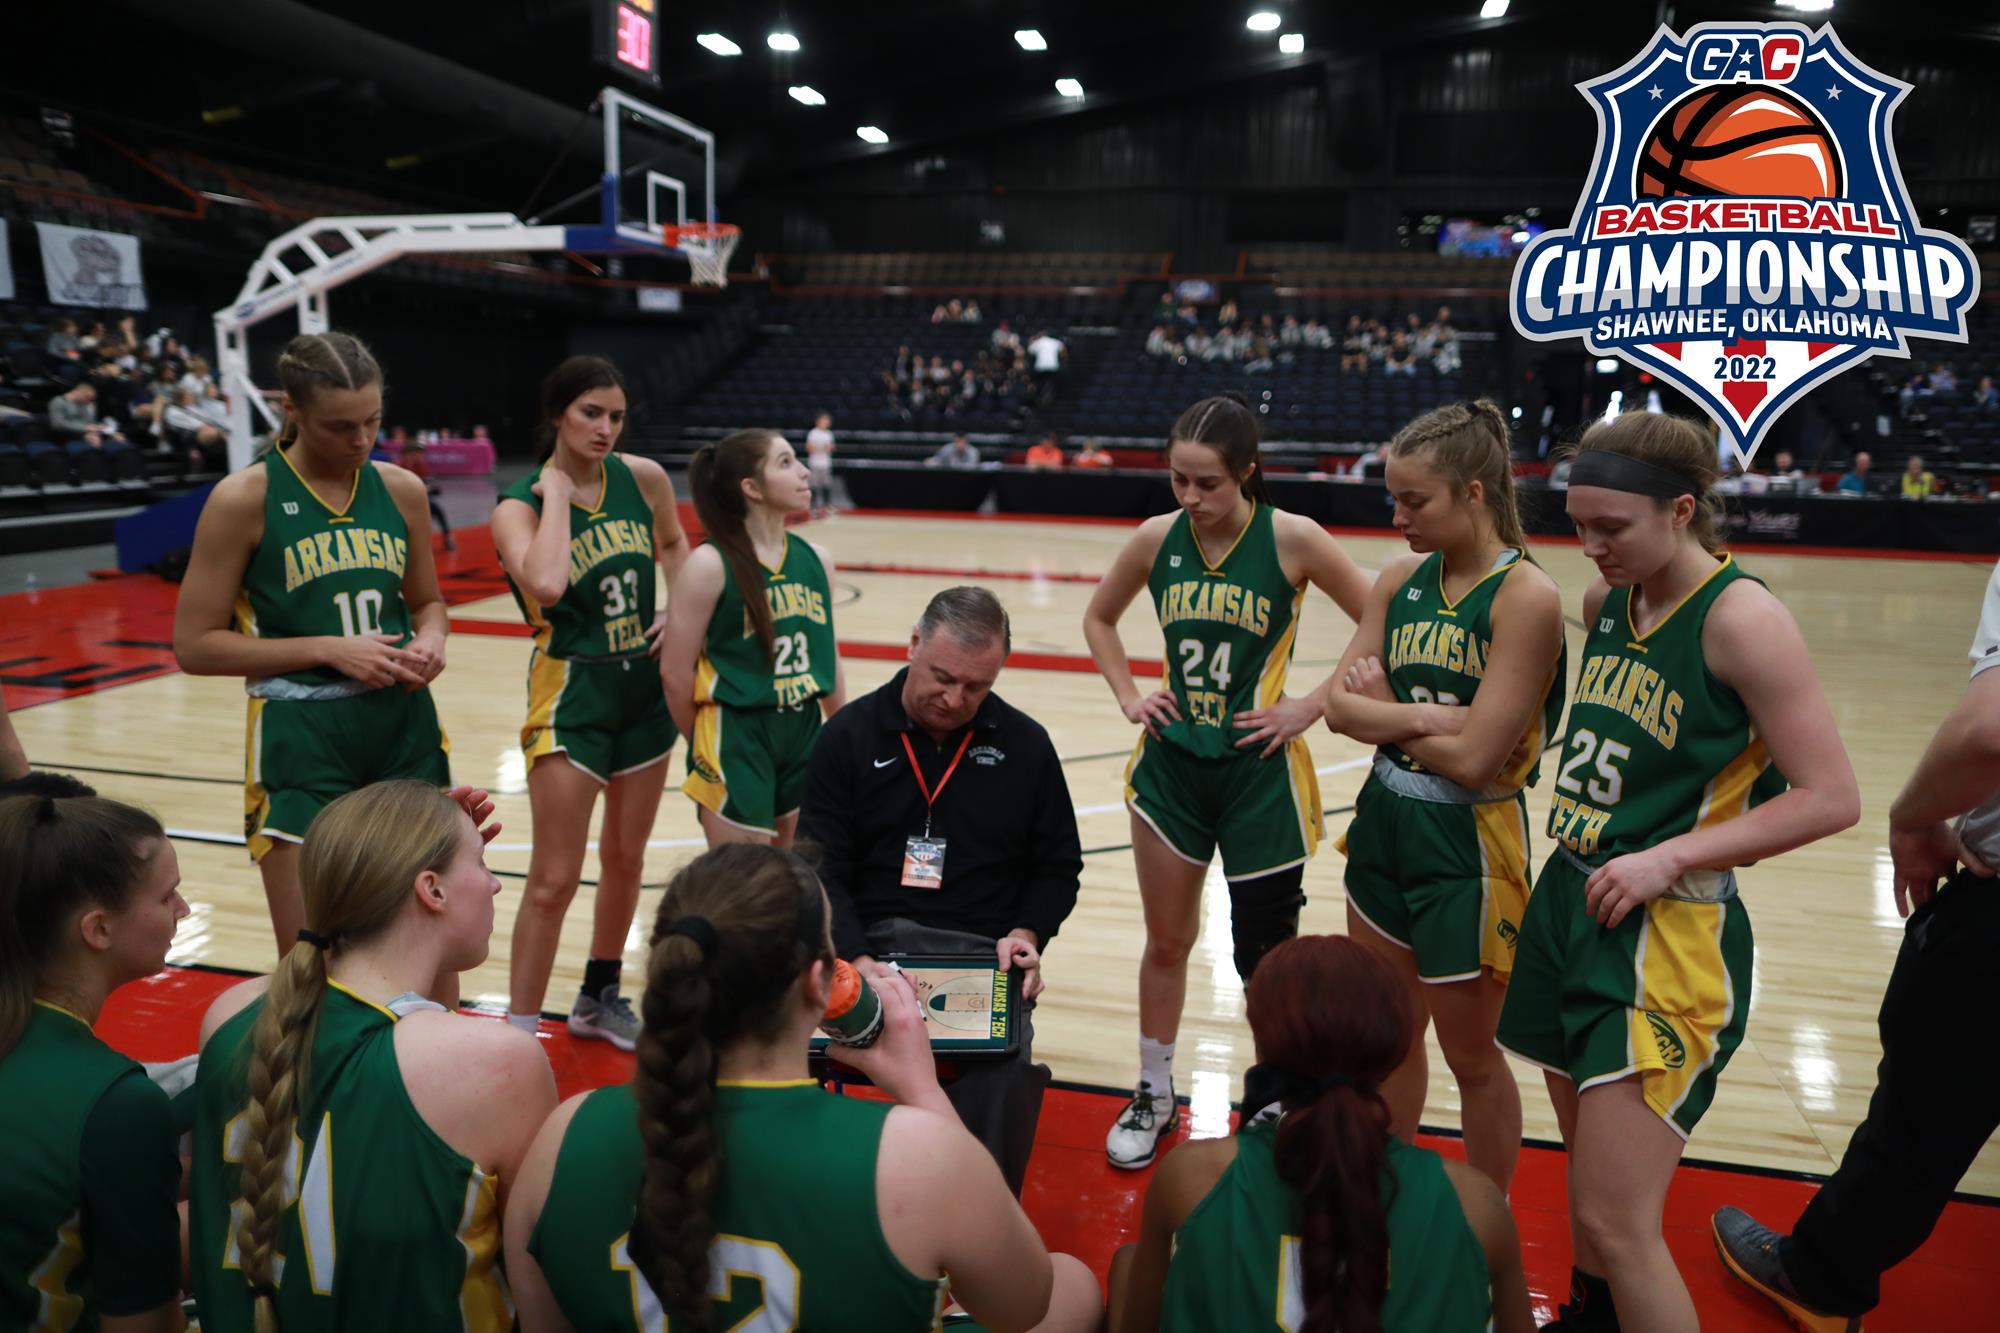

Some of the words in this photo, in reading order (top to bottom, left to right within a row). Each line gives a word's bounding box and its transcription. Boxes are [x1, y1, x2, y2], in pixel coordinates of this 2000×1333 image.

[617, 6, 650, 70] 30
[284, 528, 406, 592] ARKANSAS
[1160, 580, 1271, 637] ARKANSAS
[773, 632, 811, 675] 23
[1179, 639, 1232, 690] 24
[1557, 728, 1632, 806] 25
